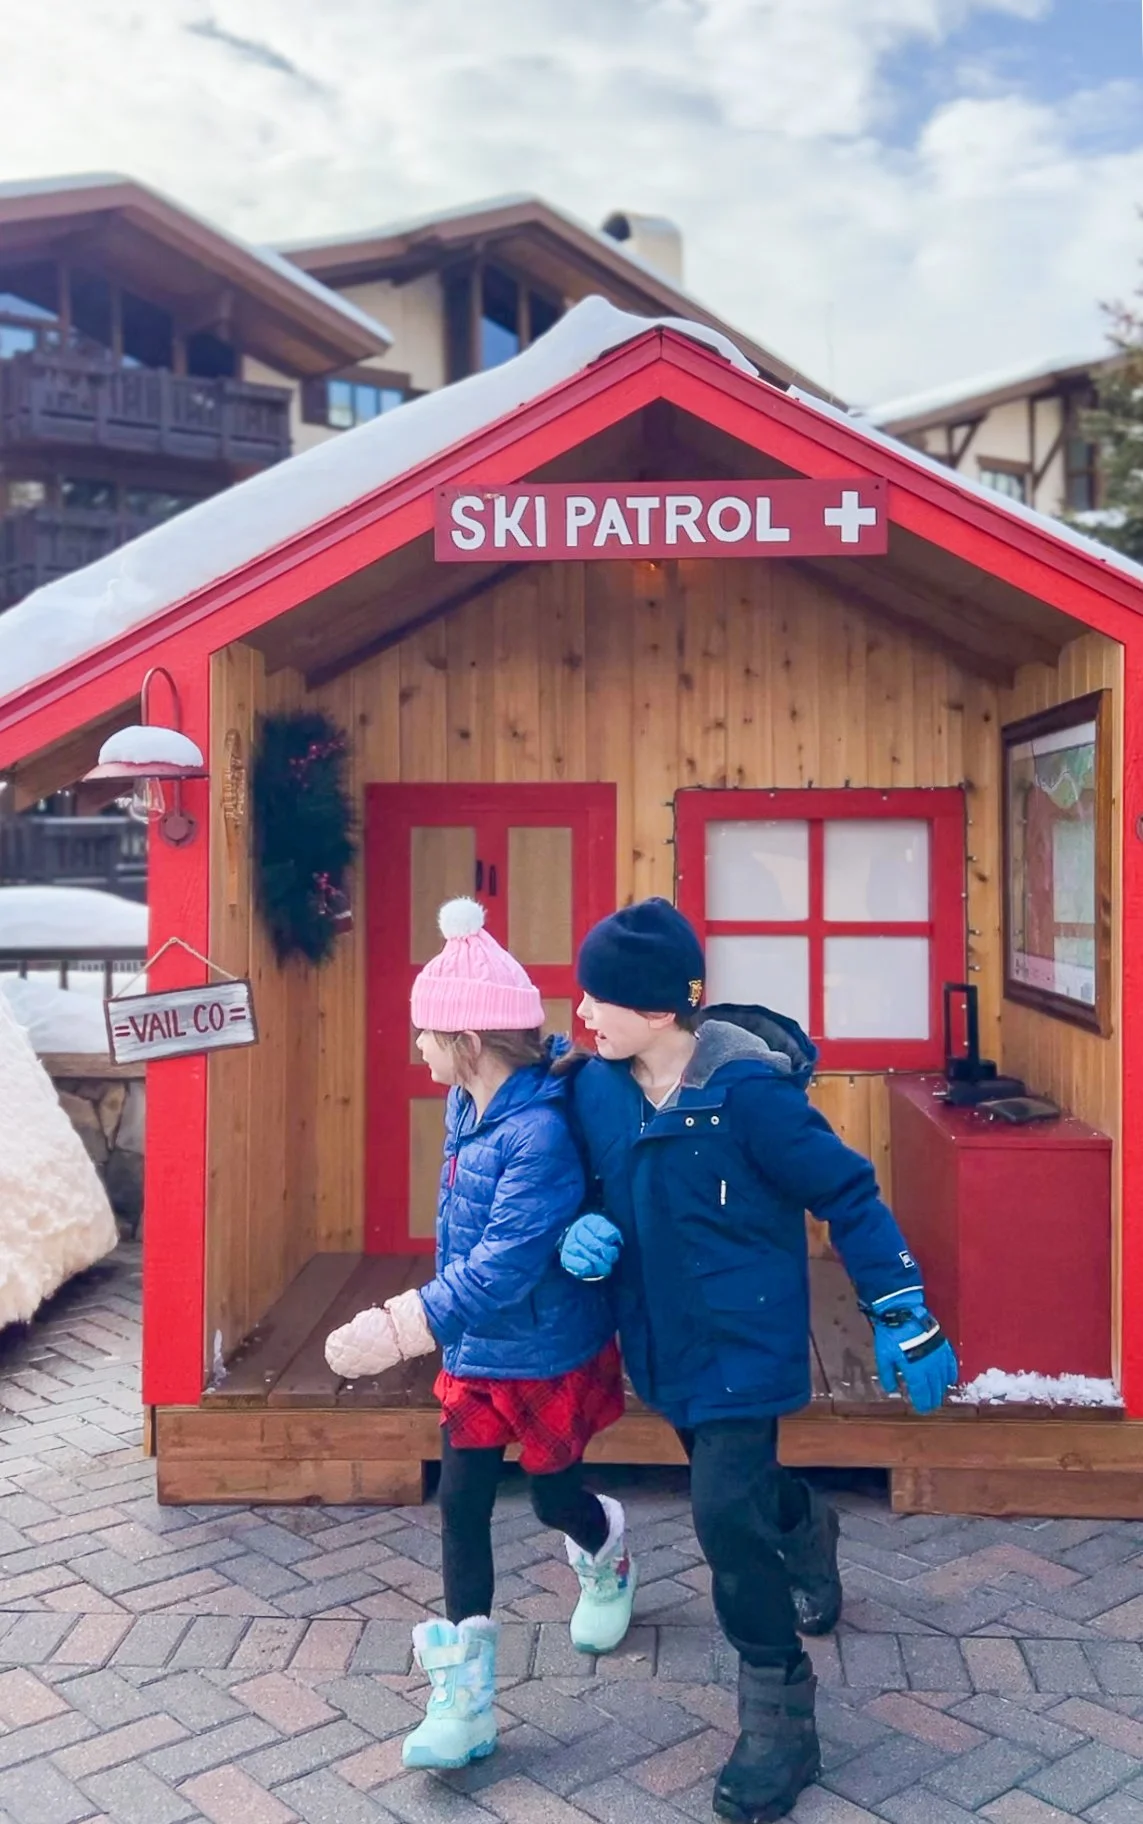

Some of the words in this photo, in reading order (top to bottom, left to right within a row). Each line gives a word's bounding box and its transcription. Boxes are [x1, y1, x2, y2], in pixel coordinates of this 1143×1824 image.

[450, 495, 547, 550] SKI
[565, 496, 790, 547] PATROL
[128, 1008, 187, 1043] VAIL
[193, 1002, 224, 1034] CO
